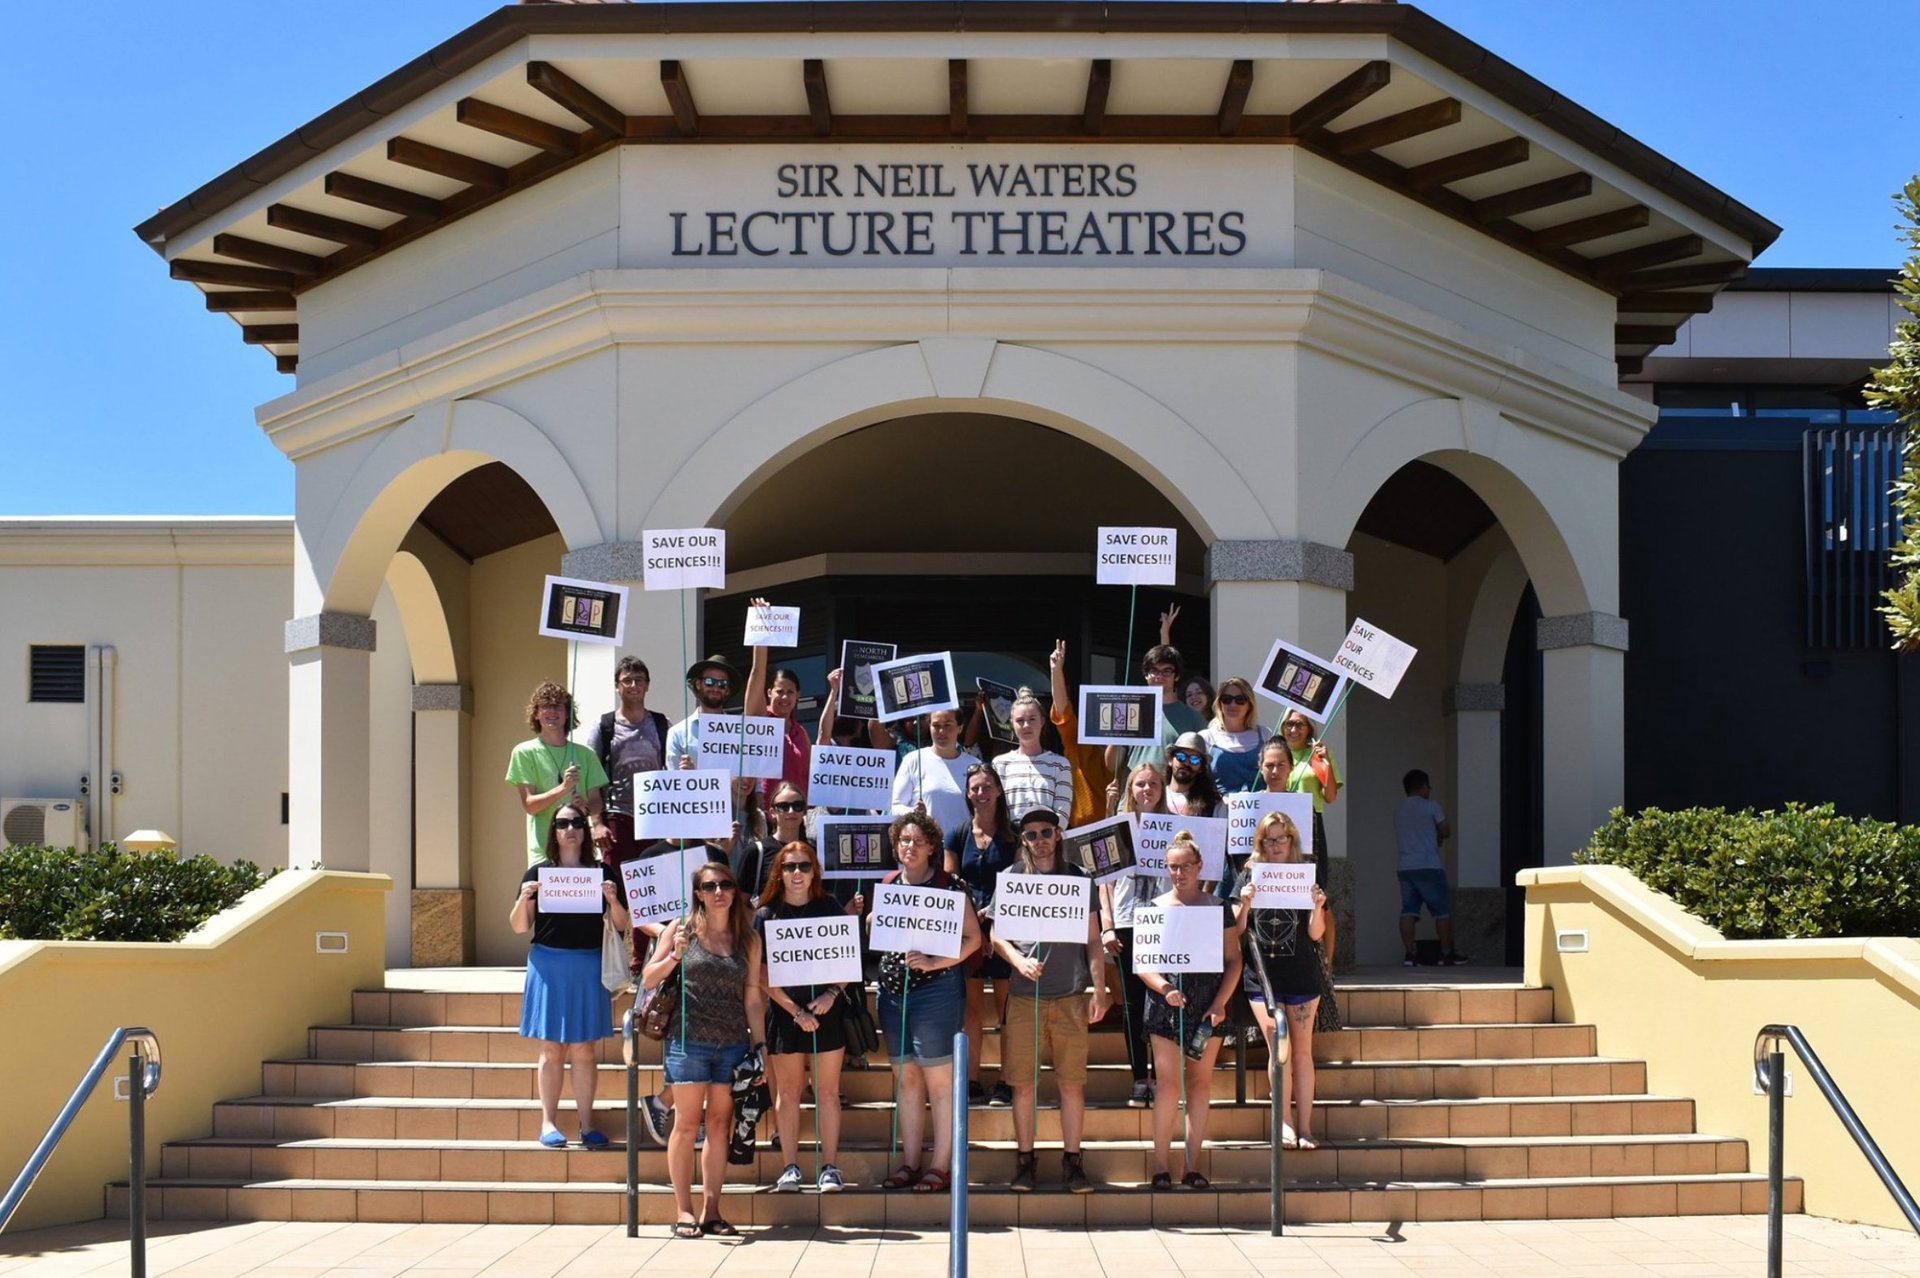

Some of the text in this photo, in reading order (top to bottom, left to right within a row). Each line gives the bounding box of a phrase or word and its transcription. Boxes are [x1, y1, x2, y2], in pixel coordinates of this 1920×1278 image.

[777, 164, 1137, 197] SIR NEIL WATERS
[669, 210, 1247, 256] LECTURE THEATRES
[652, 536, 717, 549] SAVE OUR
[1106, 534, 1168, 546] SAVE OUR
[648, 554, 721, 570] SCIENCES!!!
[1101, 553, 1172, 565] SCIENCES!!!
[750, 625, 793, 633] SCIENCES!!!!
[1353, 624, 1375, 642] SAVE
[858, 647, 887, 656] NORTH
[1345, 640, 1363, 655] OUR
[1336, 655, 1375, 681] SCIENCES
[708, 721, 775, 736] SAVE OUR
[702, 741, 778, 757] SCIENCES!!!
[819, 753, 885, 769] SAVE OUR
[643, 776, 720, 792] SAVE OUR
[813, 773, 889, 789] SCIENCES!!!
[639, 799, 726, 815] SCIENCES!!!
[1231, 800, 1260, 810] SAVE
[1143, 820, 1173, 832] SAVE
[1231, 819, 1256, 829] OUR
[1141, 839, 1167, 850] OUR
[1231, 837, 1254, 847] SCIE
[1139, 858, 1167, 869] SCIE
[549, 875, 592, 884] SAVE OUR
[625, 865, 656, 880] SAVE
[1262, 871, 1284, 879] SAVE
[544, 889, 596, 897] SCIENCES!!!!
[629, 885, 656, 899] OUR
[1006, 881, 1080, 897] SAVE OUR
[1257, 885, 1309, 893] SCIENCES!!!!
[633, 898, 688, 919] SCIENCES
[883, 892, 955, 911] SAVE OUR
[999, 902, 1084, 919] SCIENCES!!!
[876, 914, 958, 935] SCIENCES!!!
[1136, 913, 1164, 924] SAVE
[776, 923, 849, 941] SAVE OUR
[1136, 933, 1160, 945] OUR
[772, 945, 856, 963] SCIENCES!!!
[1135, 953, 1190, 965] SCIENCES
